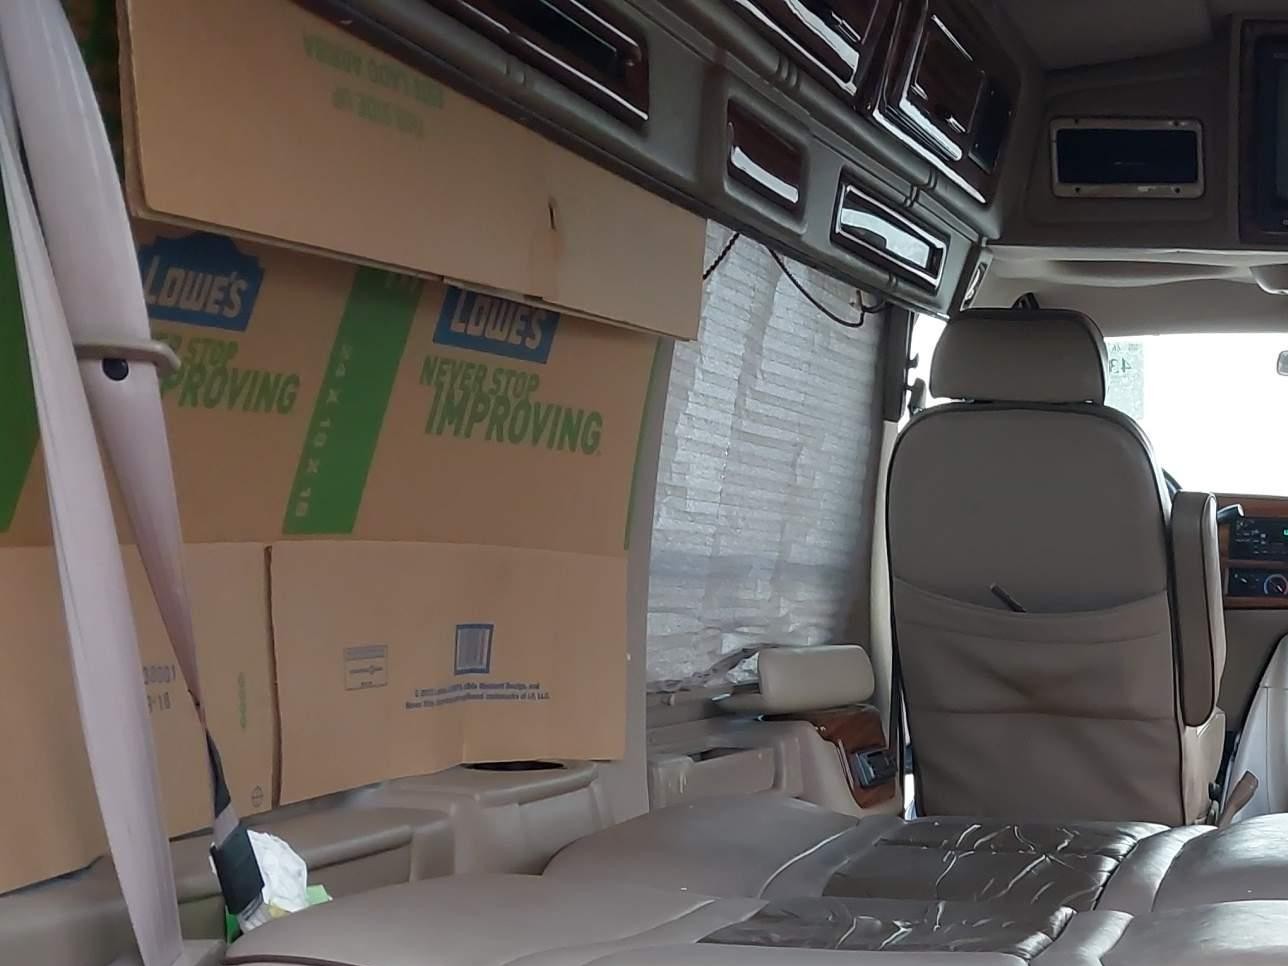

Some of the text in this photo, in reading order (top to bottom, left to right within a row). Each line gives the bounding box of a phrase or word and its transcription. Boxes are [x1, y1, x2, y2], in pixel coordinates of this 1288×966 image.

[146, 254, 248, 319] LOWE'S
[451, 289, 547, 350] LOWES
[420, 354, 540, 399] NEVER STOP
[424, 384, 603, 455] IMPROVING
